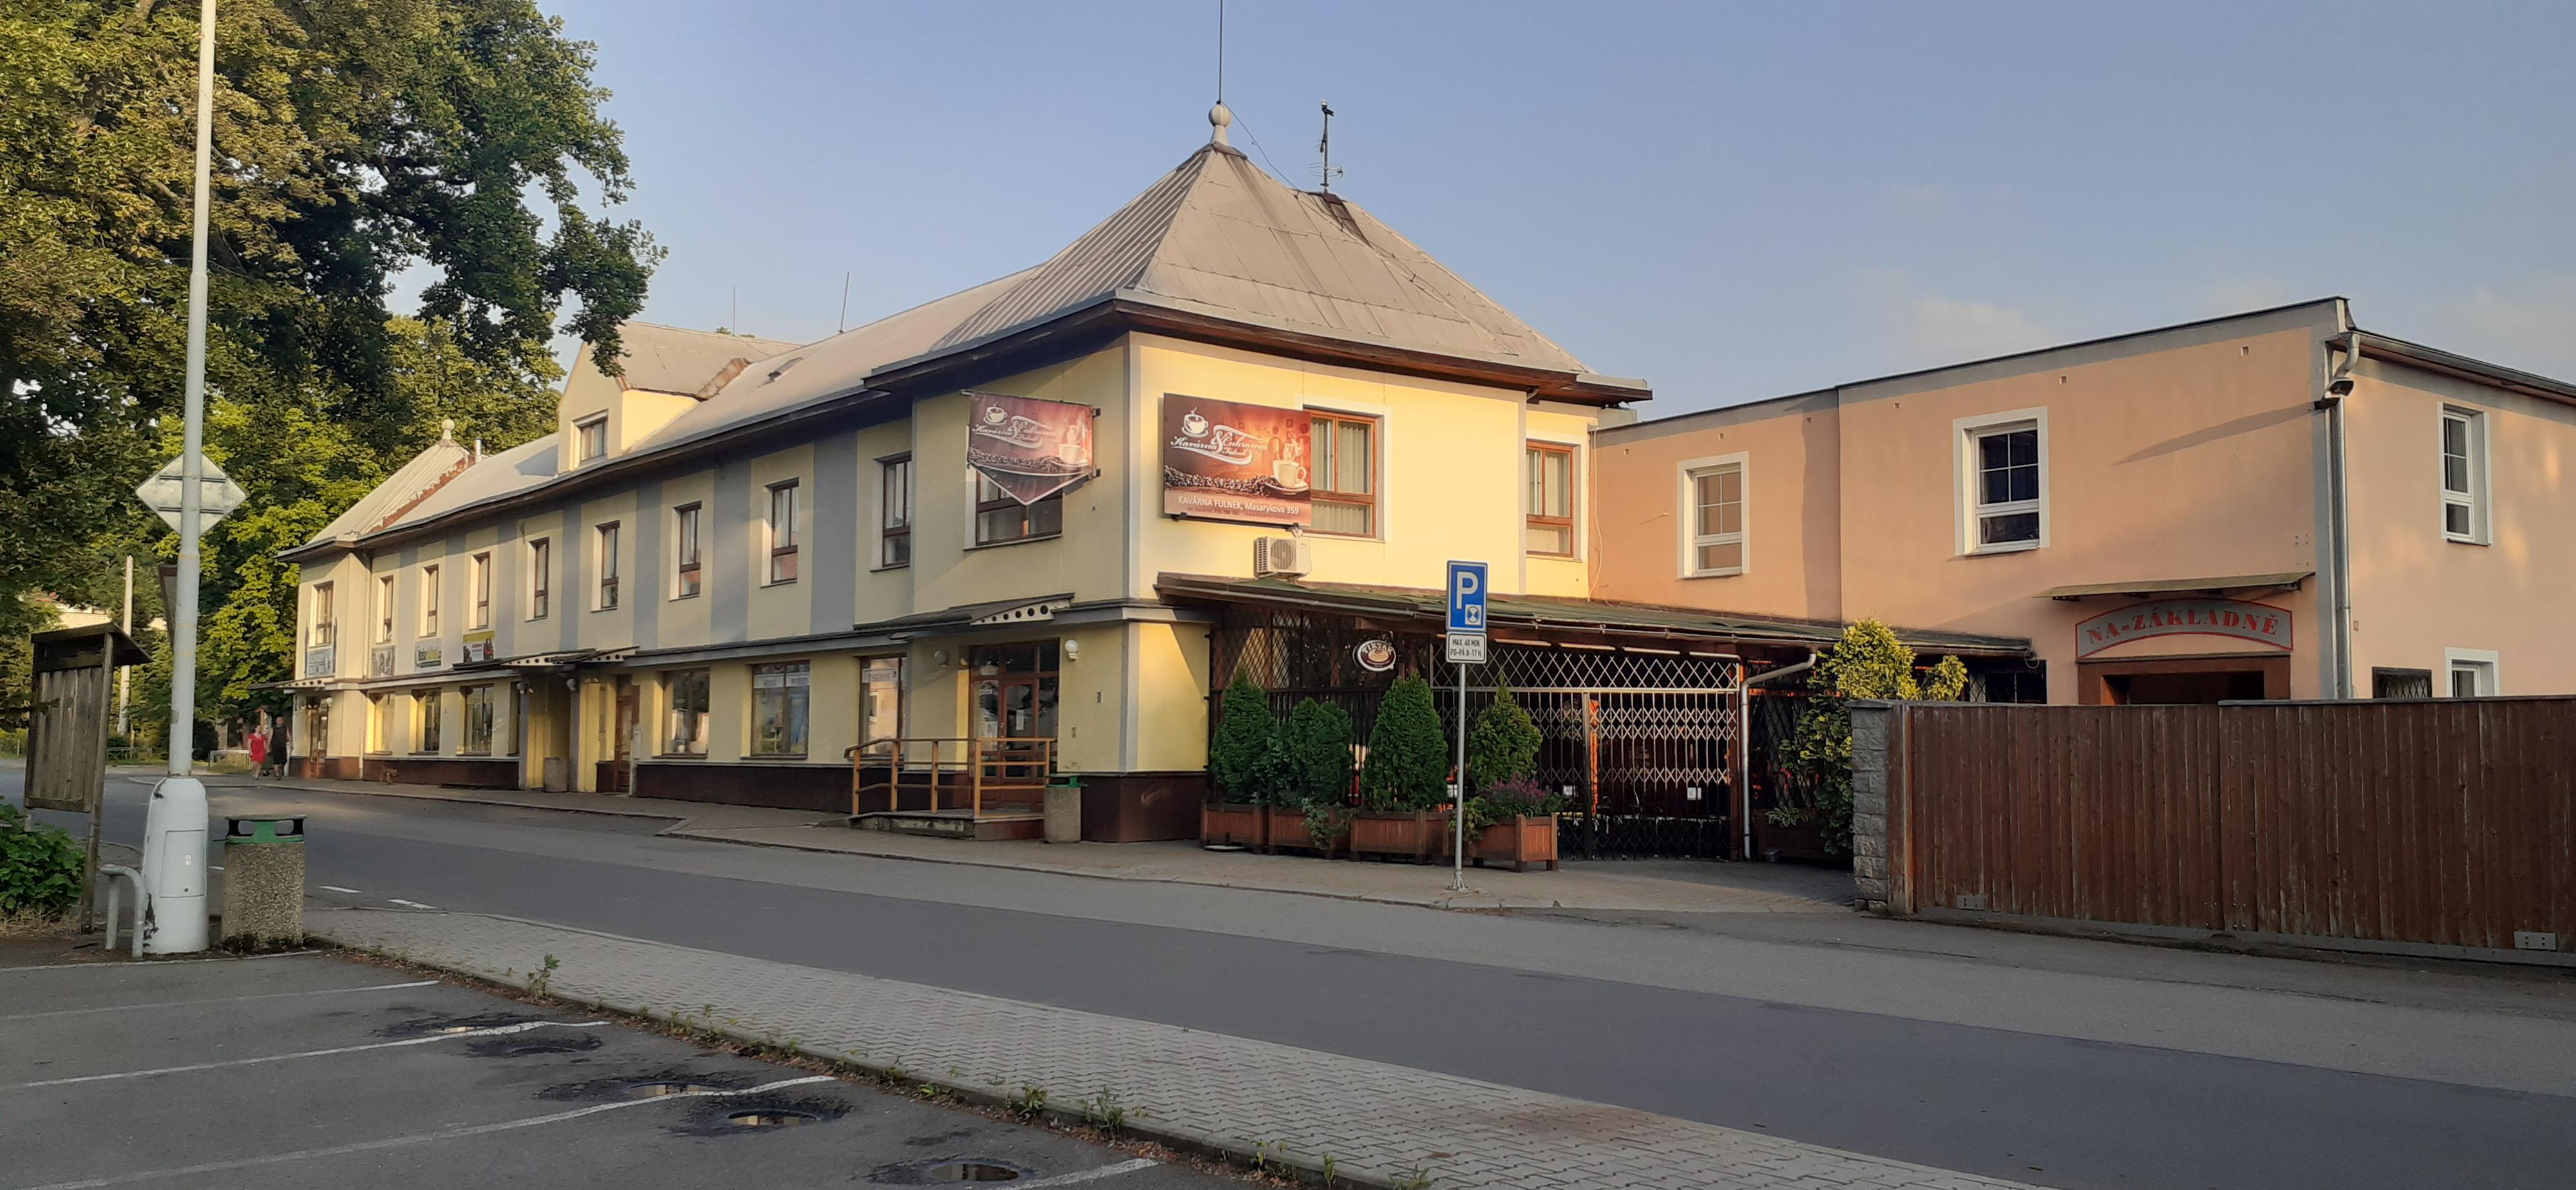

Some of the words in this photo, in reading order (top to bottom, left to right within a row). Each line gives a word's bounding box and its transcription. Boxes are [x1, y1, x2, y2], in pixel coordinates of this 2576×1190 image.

[1170, 436, 1217, 449] Kavárna
[1211, 431, 1223, 453] &
[1178, 495, 1213, 507] KAVÁRNA
[1214, 499, 1243, 510] FULNEK,
[1245, 502, 1285, 513] Masarykova
[1287, 506, 1299, 515] 359
[1456, 571, 1479, 610] P
[2087, 607, 2278, 644] NA-ZÁKLADNĚ
[1362, 643, 1393, 654] TIKTAK
[1450, 647, 1465, 656] PO-PÁ
[1452, 638, 1463, 647] MAX.
